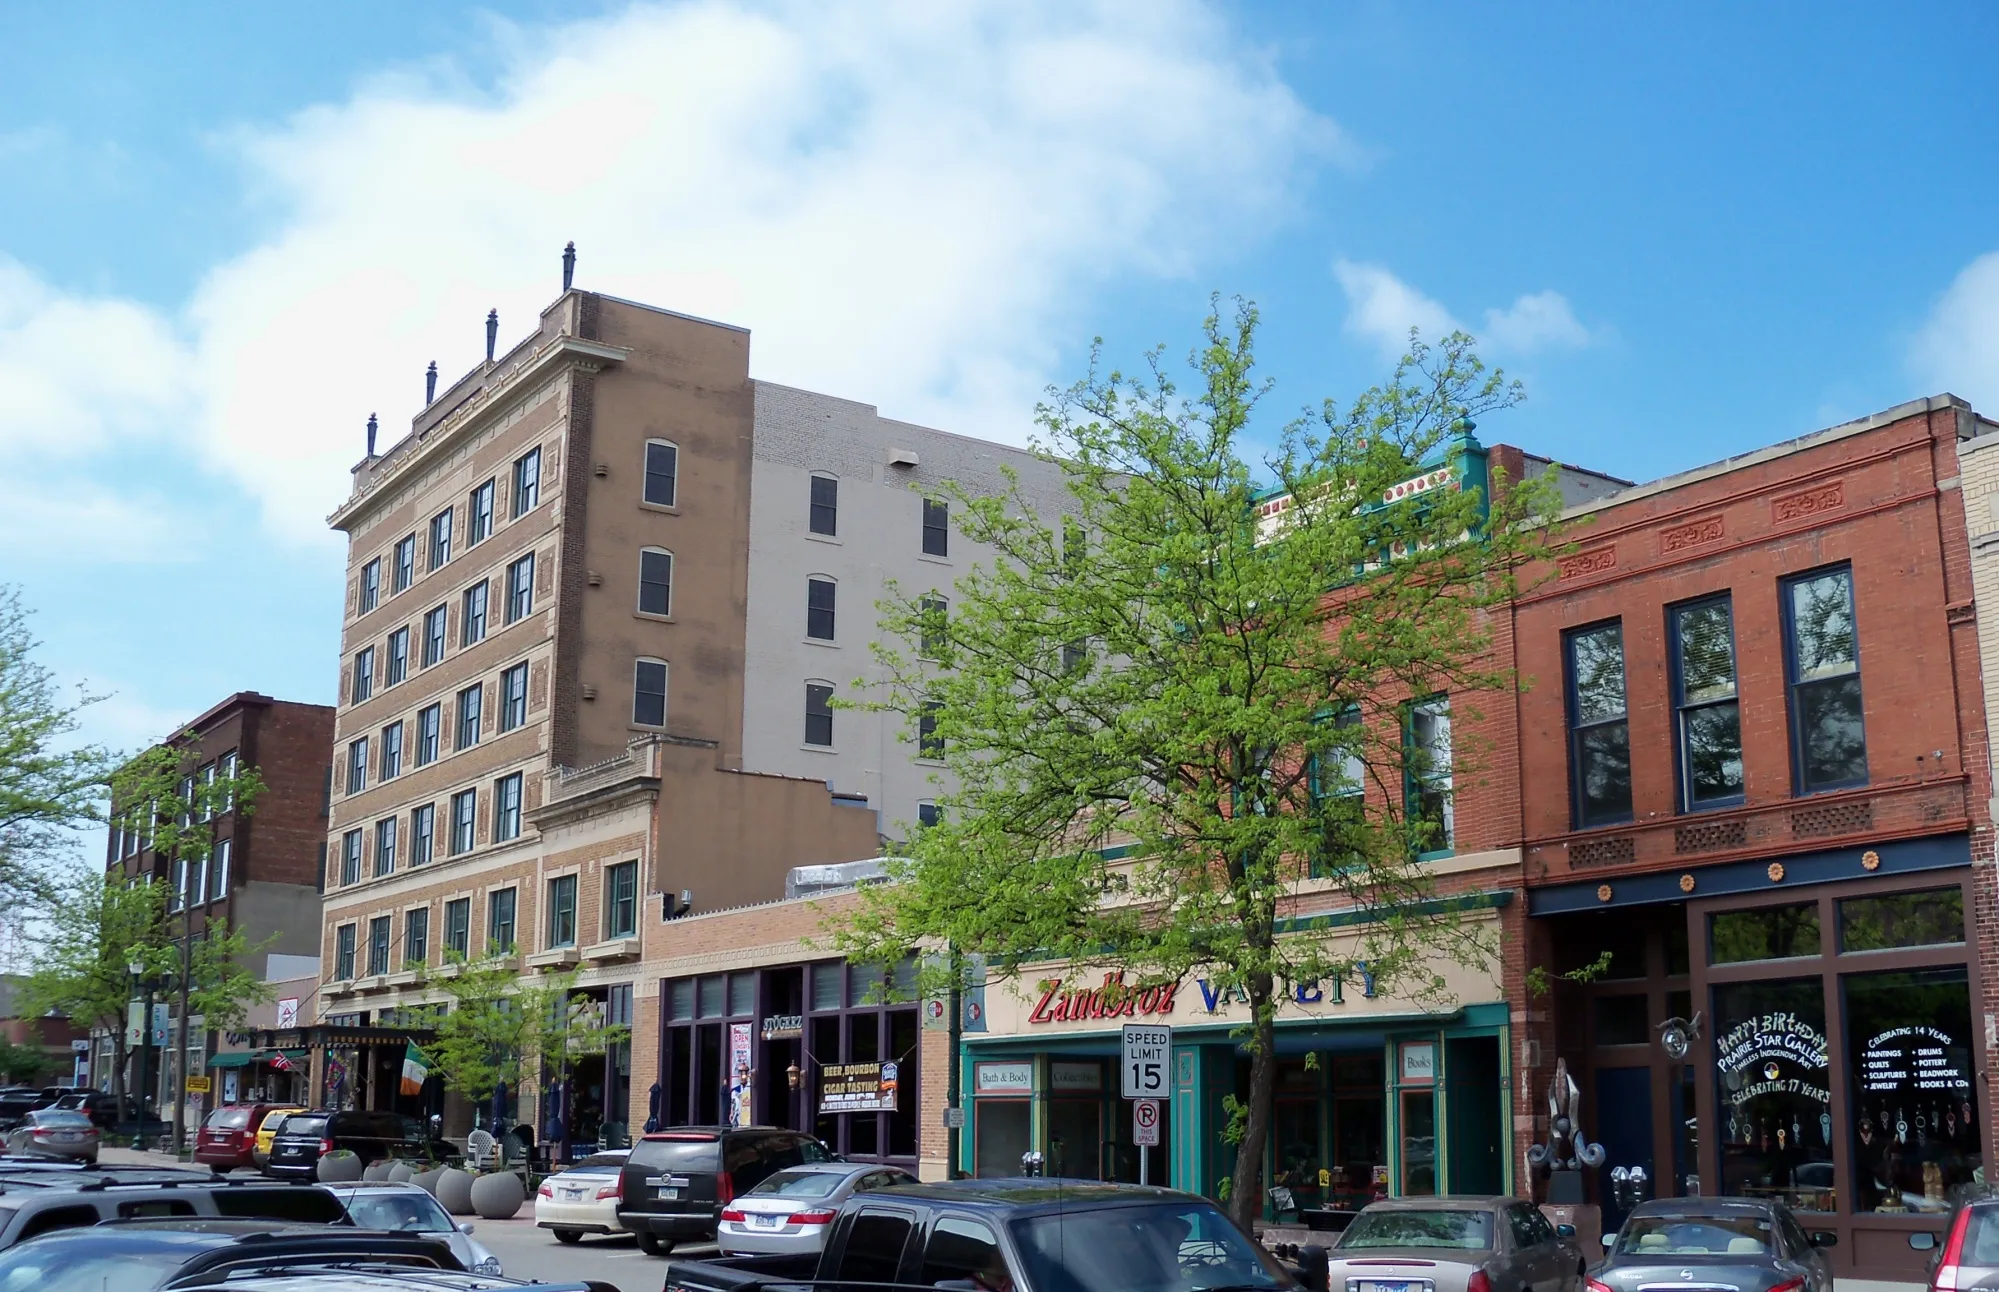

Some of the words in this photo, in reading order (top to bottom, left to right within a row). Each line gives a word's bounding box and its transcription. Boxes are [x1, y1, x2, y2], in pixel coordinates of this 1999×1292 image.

[1028, 967, 1180, 1024] Zandbroz
[1196, 960, 1382, 1014] VAIETY
[734, 1034, 749, 1043] OPEN
[1127, 1033, 1167, 1045] SPEED
[1717, 1016, 1758, 1055] HAPPY
[1868, 1027, 1912, 1049] CELEBRATING
[1914, 1026, 1926, 1035] 14
[1928, 1027, 1952, 1045] YEARS
[1131, 1048, 1162, 1060] LIMIT
[1717, 1040, 1753, 1073] PRAIRIE
[1753, 1032, 1782, 1049] STAR
[1784, 1033, 1828, 1068] GALLERY
[1867, 1050, 1901, 1058] PAINTINGS
[1917, 1048, 1943, 1056] DRUMS
[1407, 1055, 1431, 1069] Books
[1732, 1052, 1759, 1073] TIMELESS
[1760, 1049, 1797, 1061] INDIGENOUS
[1797, 1056, 1813, 1071] ART
[1918, 1059, 1947, 1067] POTTERY
[844, 1063, 880, 1076] BOURBON
[1869, 1071, 1907, 1079] SCULPTURES
[1919, 1069, 1959, 1078] BEADWORK
[982, 1072, 999, 1083] Bath
[1000, 1073, 1008, 1082] &
[1009, 1071, 1029, 1085] Body
[1132, 1063, 1161, 1090] 15
[823, 1083, 846, 1095] CIGAR
[846, 1081, 878, 1093] TASTING
[1869, 1082, 1898, 1090] JEWELRY
[1920, 1080, 1945, 1089] BOOKS
[1946, 1080, 1953, 1088] &
[1731, 1079, 1786, 1105] CELEBRATING
[1788, 1079, 1800, 1092] 17
[1801, 1082, 1831, 1104] YEARS
[1140, 1128, 1153, 1136] THIS
